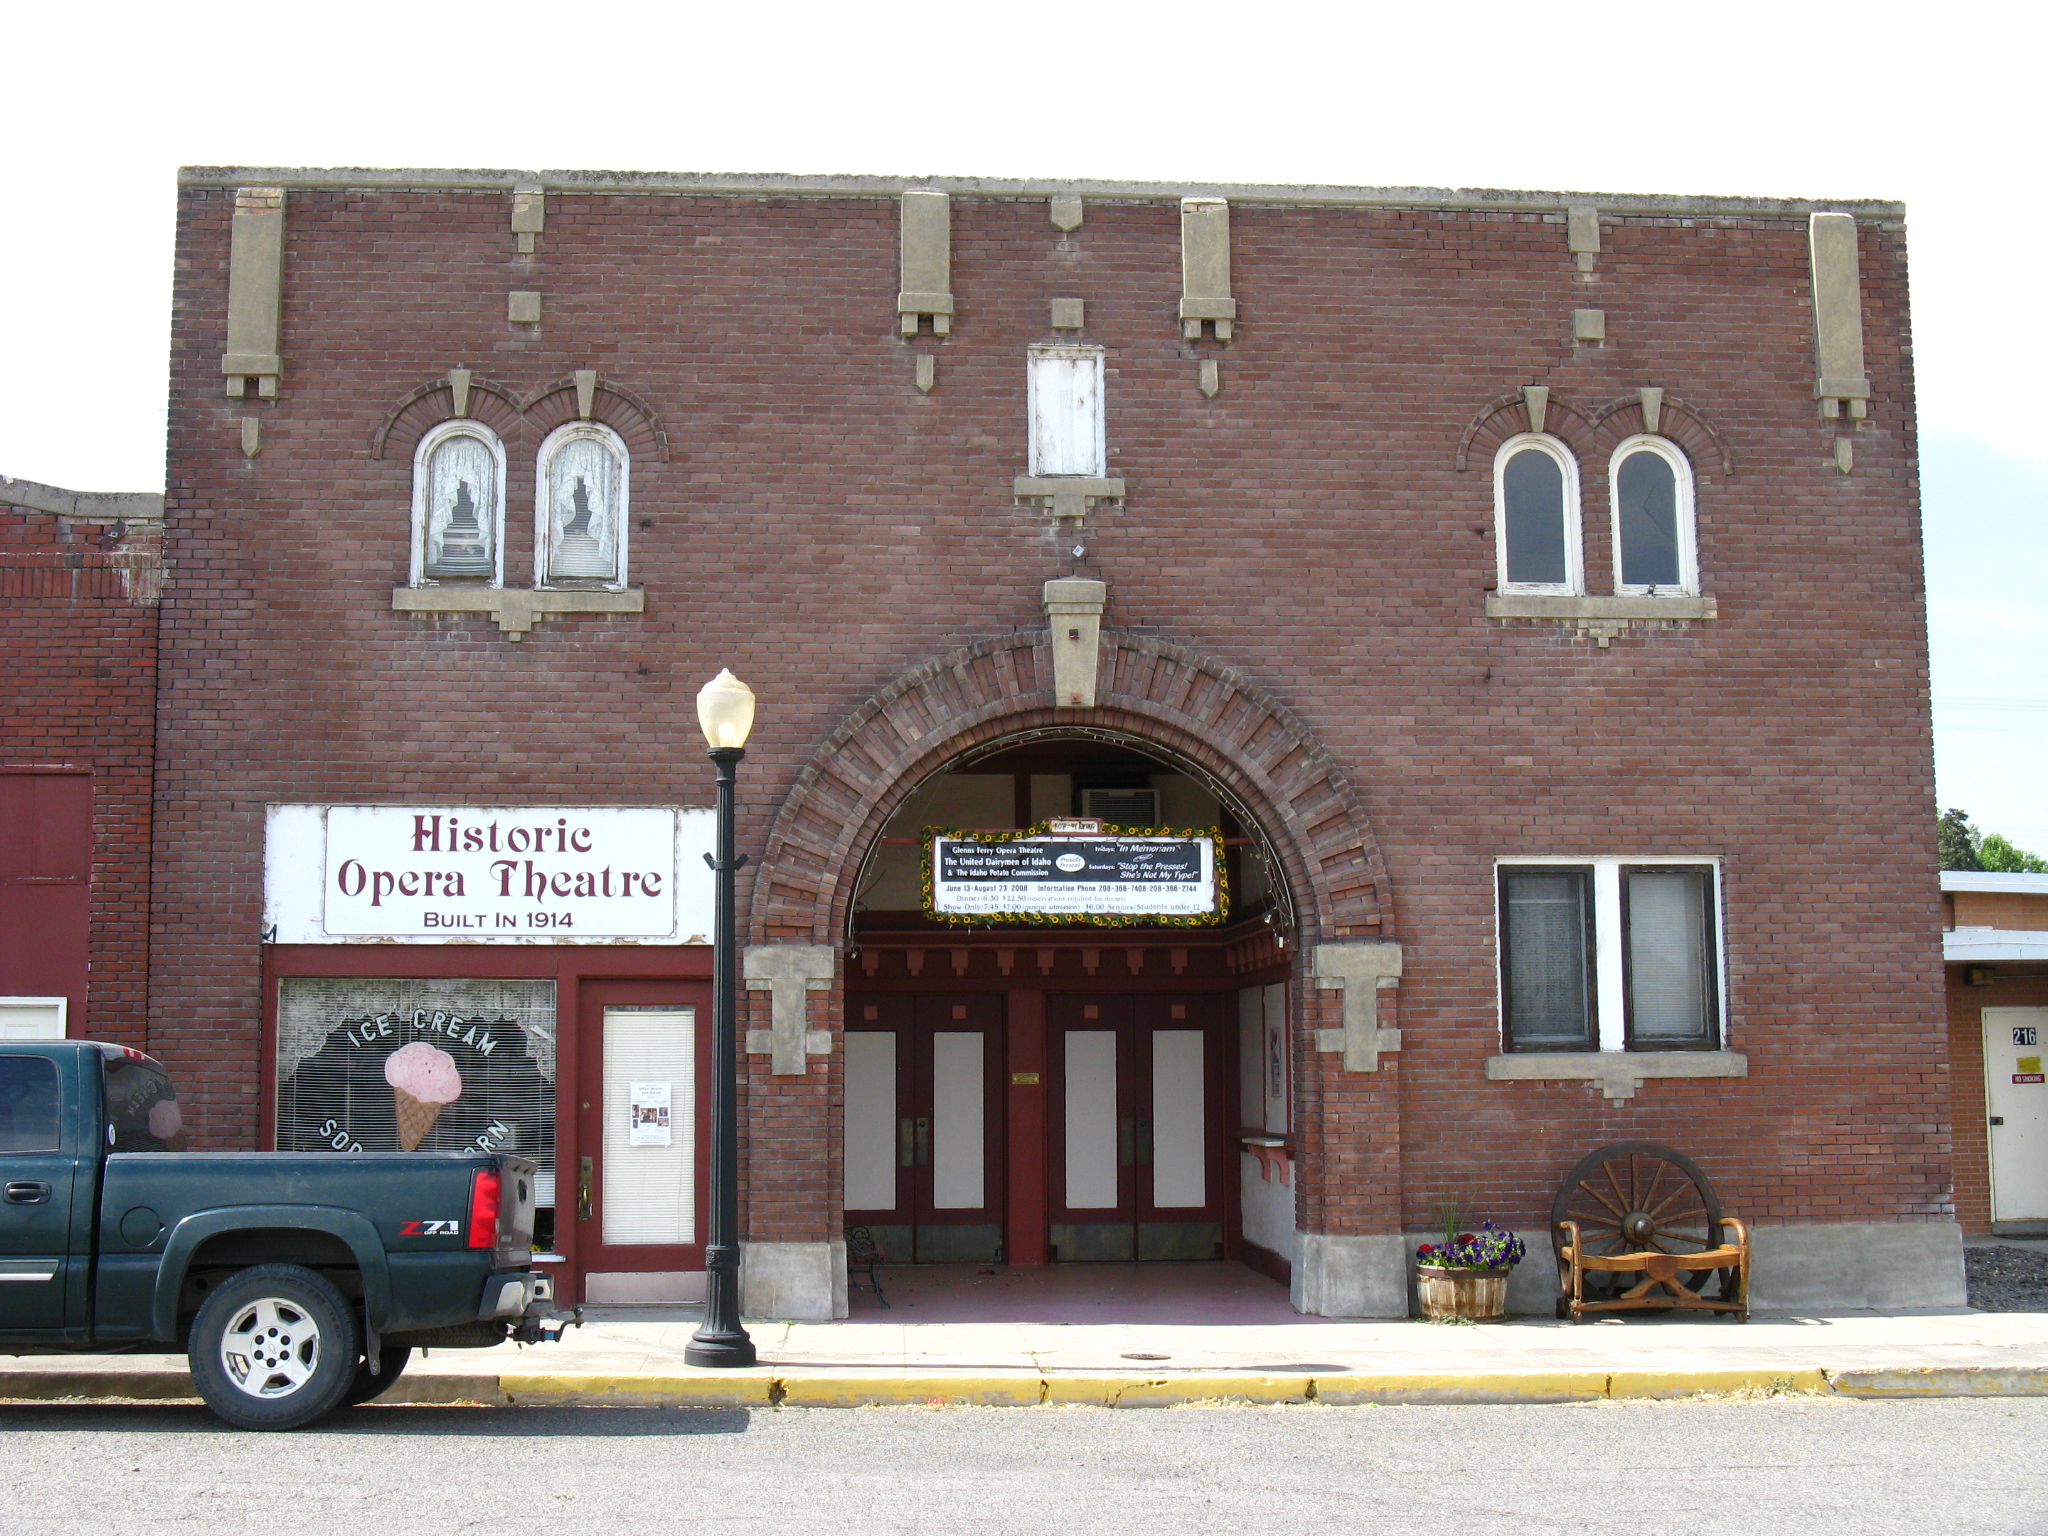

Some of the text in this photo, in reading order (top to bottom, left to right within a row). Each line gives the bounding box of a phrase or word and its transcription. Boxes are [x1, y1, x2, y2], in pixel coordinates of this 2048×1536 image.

[410, 815, 593, 853] Historic
[952, 846, 1044, 856] Glenns Ferry Opera Theatre
[944, 857, 1052, 868] The United Dairymen of Idaho
[1089, 863, 1116, 871] Saturdays:
[1140, 862, 1153, 870] the
[1154, 862, 1188, 870] Presses!
[947, 869, 1049, 877] & The Idaho Potato Commission
[1119, 870, 1141, 879] She's
[1142, 870, 1158, 879] Not
[1158, 870, 1173, 881] My
[337, 859, 662, 906] Opera Theatre
[946, 884, 961, 892] June
[964, 884, 997, 893] 13-August
[998, 884, 1008, 892] 23
[1011, 884, 1028, 892] 2008
[1038, 884, 1075, 892] Information
[1077, 884, 1097, 892] Phone
[1067, 895, 1091, 903] required
[1104, 895, 1127, 903] dinner)
[943, 903, 961, 911] Show
[1085, 903, 1105, 911] $6.00
[1170, 903, 1191, 911] under
[1193, 903, 1201, 911] 12
[423, 912, 574, 928] BUILT IN 1914
[347, 1008, 499, 1057] ICE CREAM
[2013, 1028, 2036, 1045] 216
[2014, 1075, 2022, 1083] NO
[399, 1220, 459, 1236] Z71
